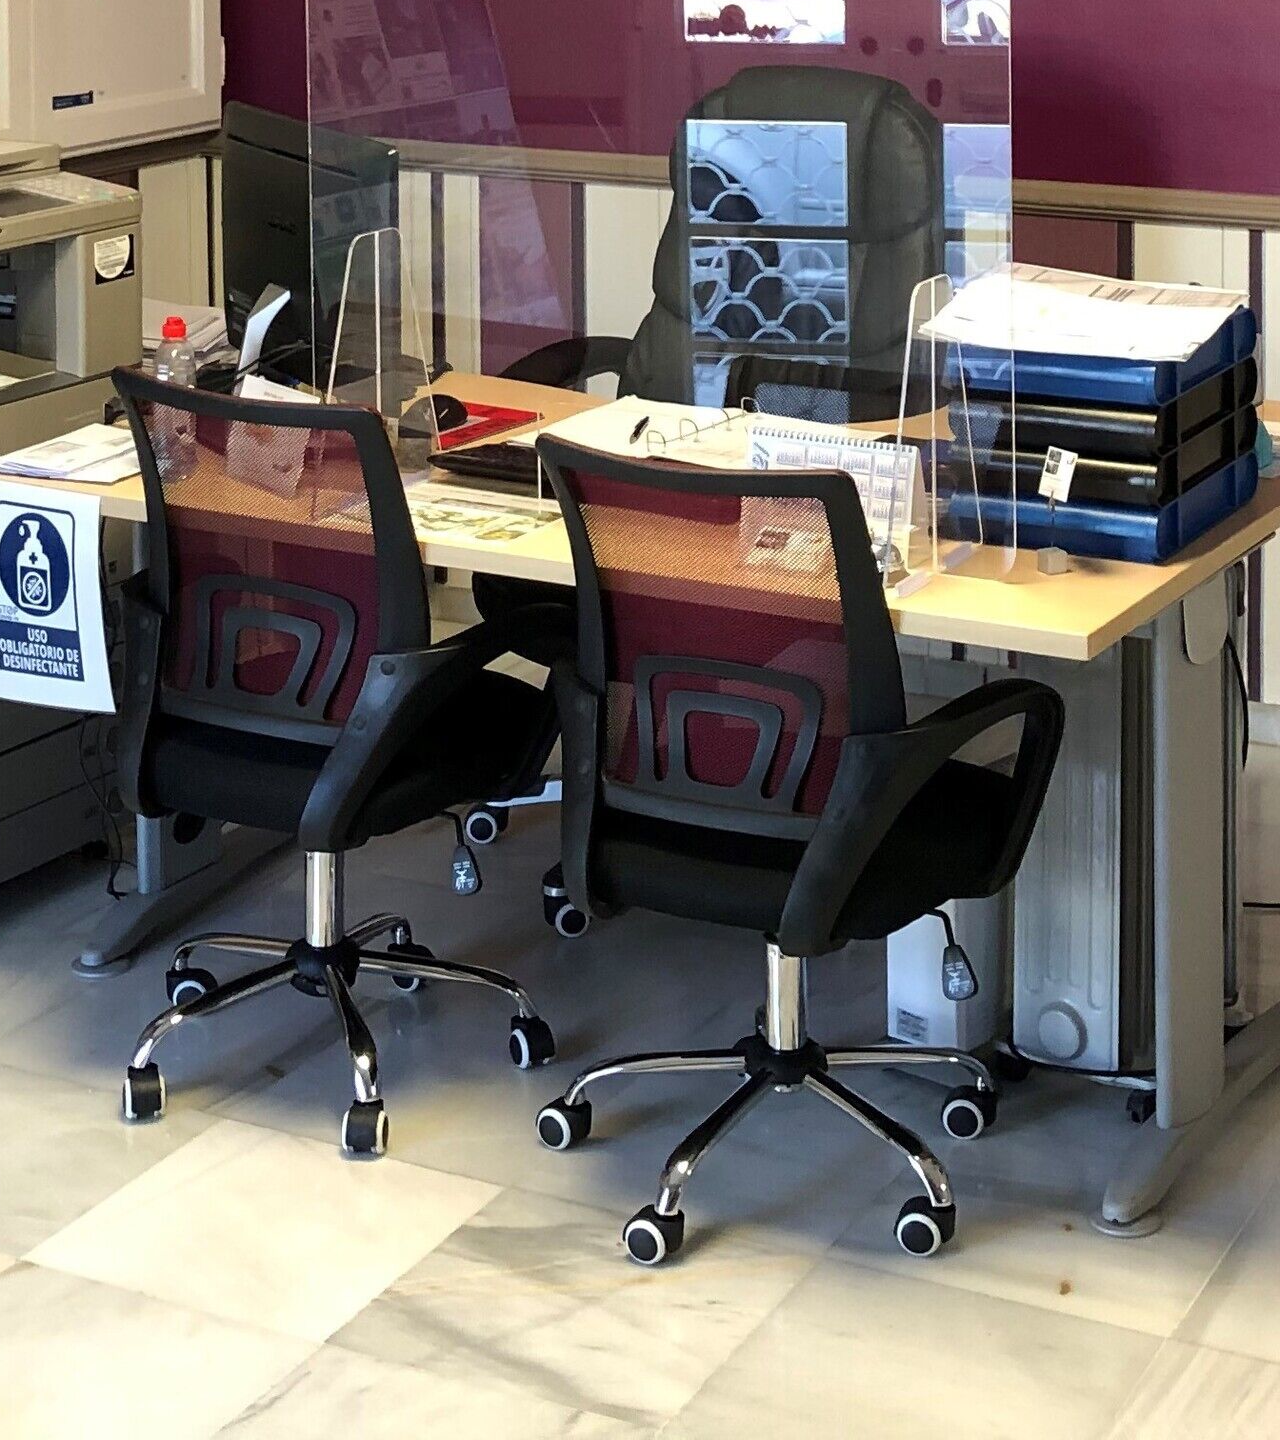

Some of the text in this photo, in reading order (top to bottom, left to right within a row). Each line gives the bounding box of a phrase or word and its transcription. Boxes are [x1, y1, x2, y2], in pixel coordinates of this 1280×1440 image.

[27, 627, 48, 643] USO
[0, 638, 80, 663] OBLIGATORIO DE
[3, 653, 79, 678] DESINFECTANTE
